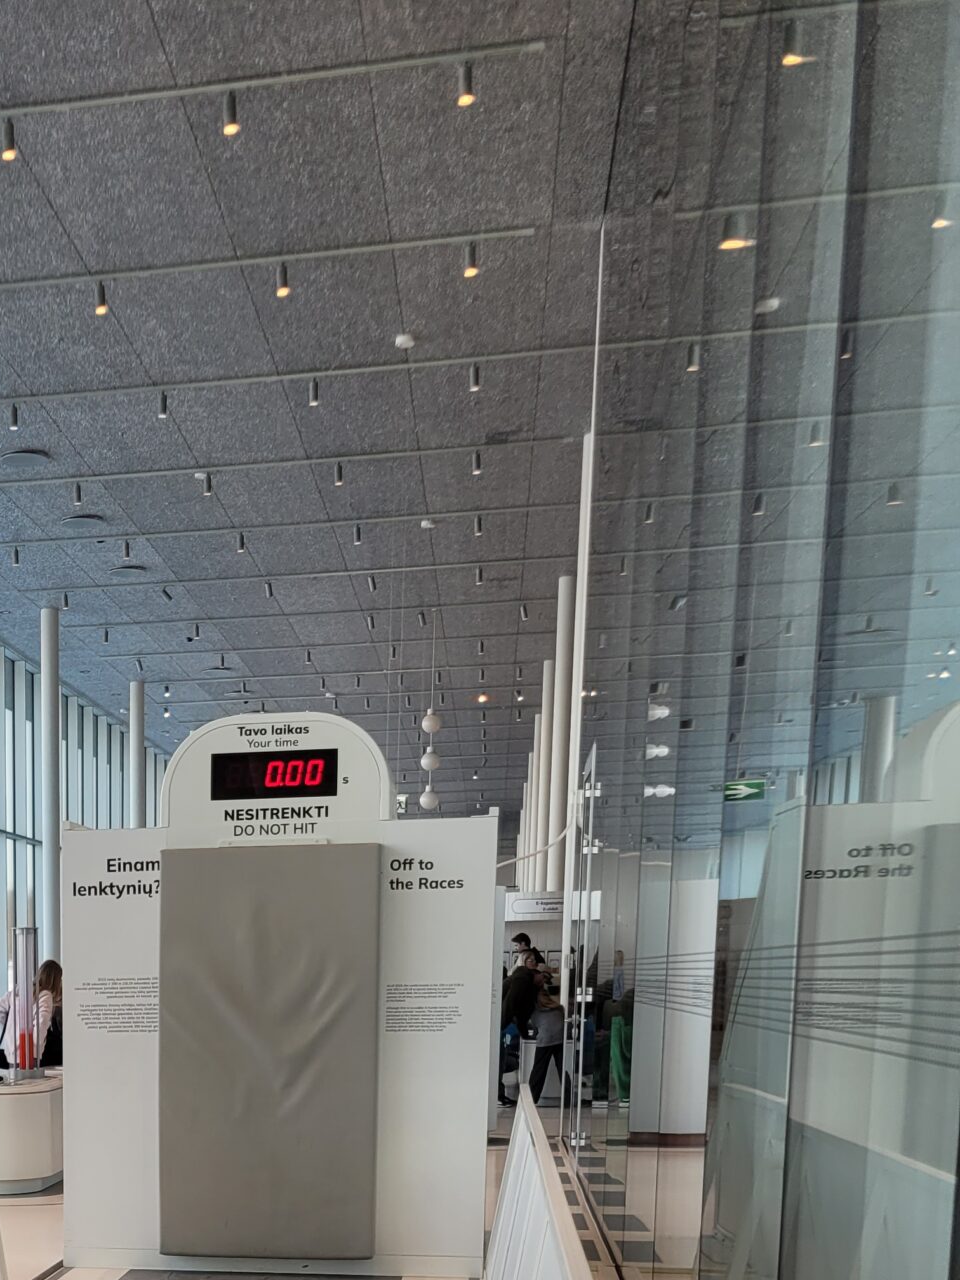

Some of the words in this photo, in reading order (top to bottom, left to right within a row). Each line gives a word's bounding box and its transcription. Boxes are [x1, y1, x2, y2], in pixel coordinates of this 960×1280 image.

[237, 726, 267, 737] Tavo
[271, 724, 310, 736] laikas
[247, 738, 270, 748] Your
[274, 737, 299, 747] time
[264, 759, 325, 788] 0.00
[342, 776, 349, 784] s
[224, 805, 329, 821] NESITRENKTI
[233, 824, 255, 837] DO
[259, 823, 290, 836] NOT
[293, 822, 318, 834] HIT
[390, 858, 415, 871] Off
[418, 859, 434, 871] to
[72, 879, 160, 900] lenktynių?
[389, 877, 414, 890] the
[418, 877, 464, 890] Races
